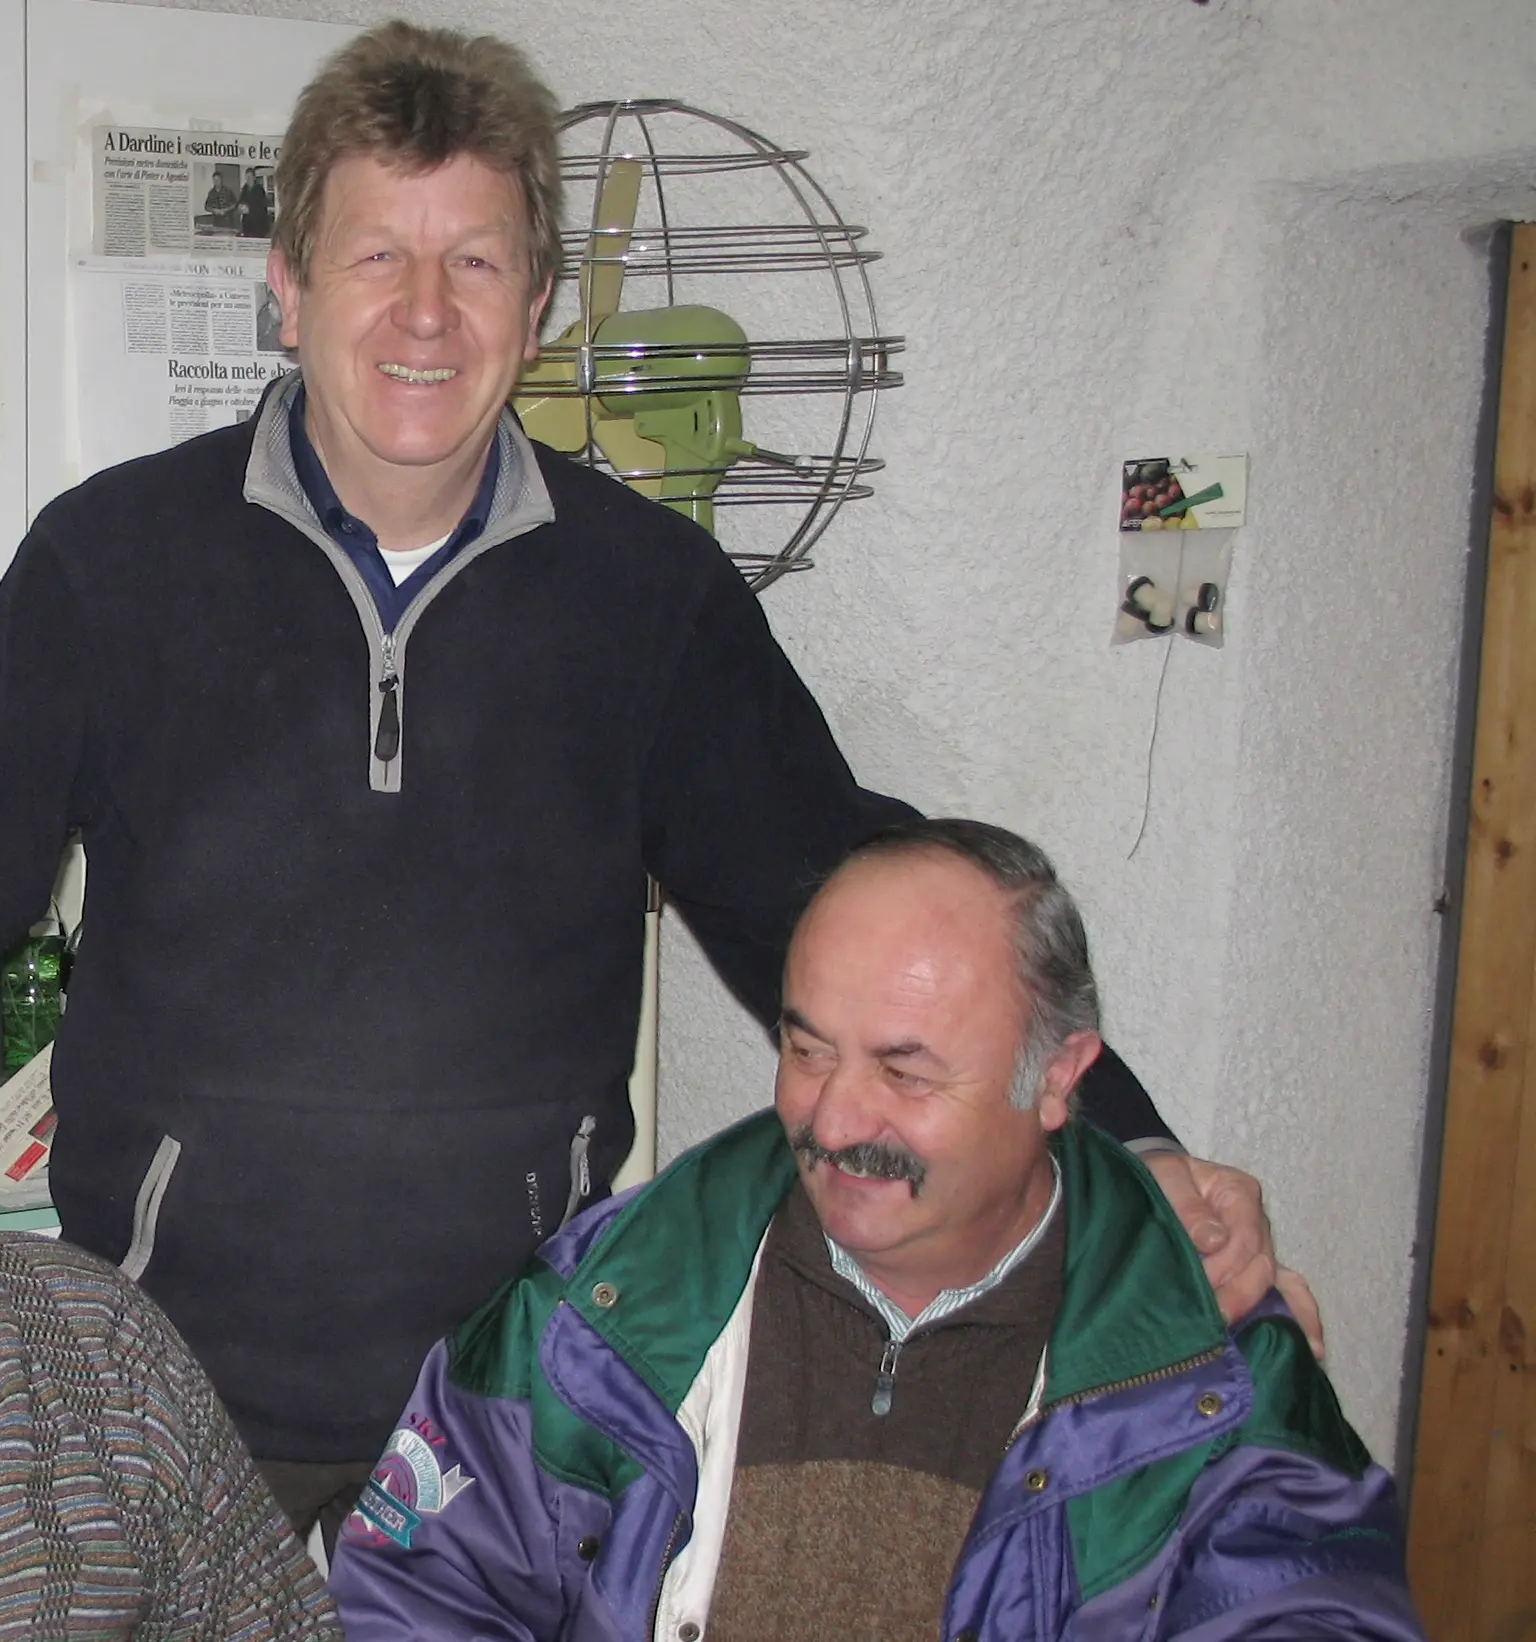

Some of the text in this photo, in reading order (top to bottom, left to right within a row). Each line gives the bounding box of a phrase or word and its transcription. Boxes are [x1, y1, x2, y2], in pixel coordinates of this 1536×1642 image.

[104, 131, 115, 151] A
[118, 132, 175, 154] Dardine
[176, 136, 182, 155] i
[185, 138, 245, 158] «santoni»
[248, 145, 258, 159] e
[259, 141, 271, 160] le
[168, 359, 228, 380] Raccolta
[231, 361, 267, 380] mele
